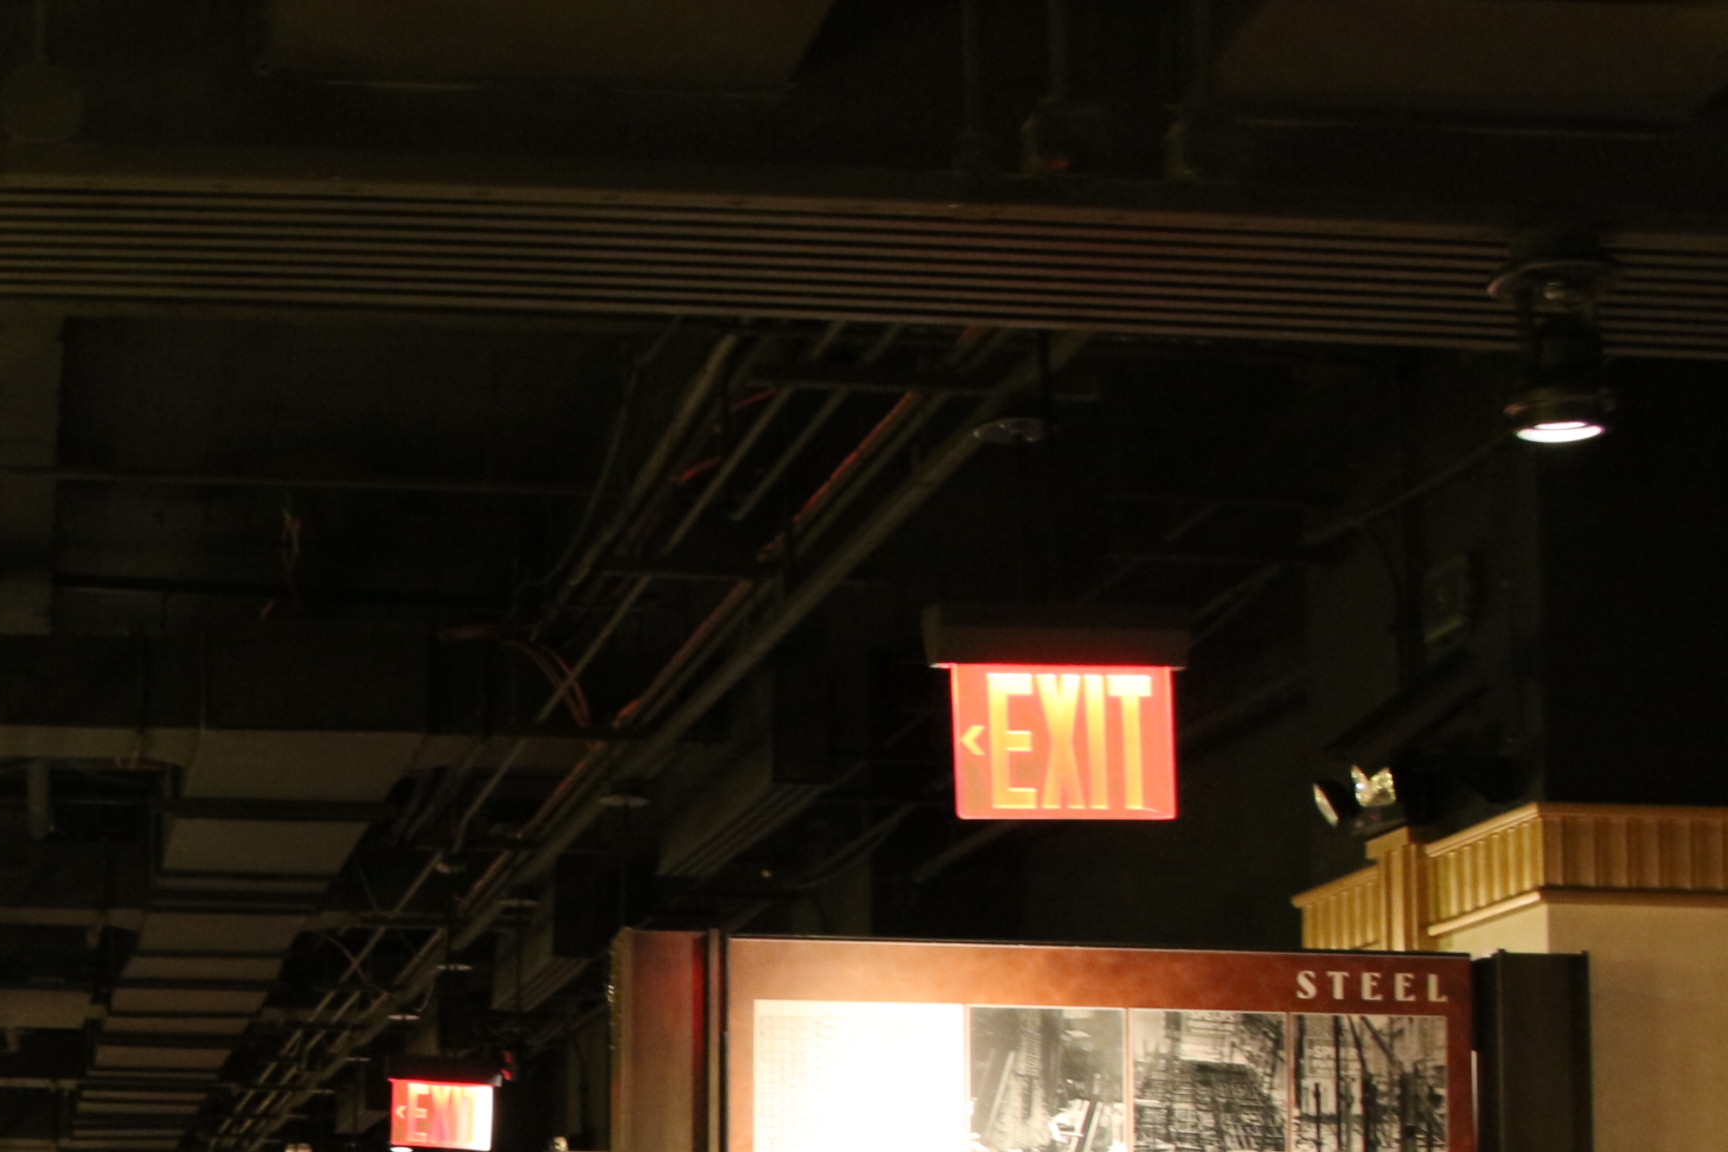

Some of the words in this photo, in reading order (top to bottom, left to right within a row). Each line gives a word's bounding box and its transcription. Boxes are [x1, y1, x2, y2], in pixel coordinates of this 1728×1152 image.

[986, 672, 1153, 810] EXIT
[1296, 969, 1449, 1003] STEEL
[406, 1082, 479, 1144] EXIT
